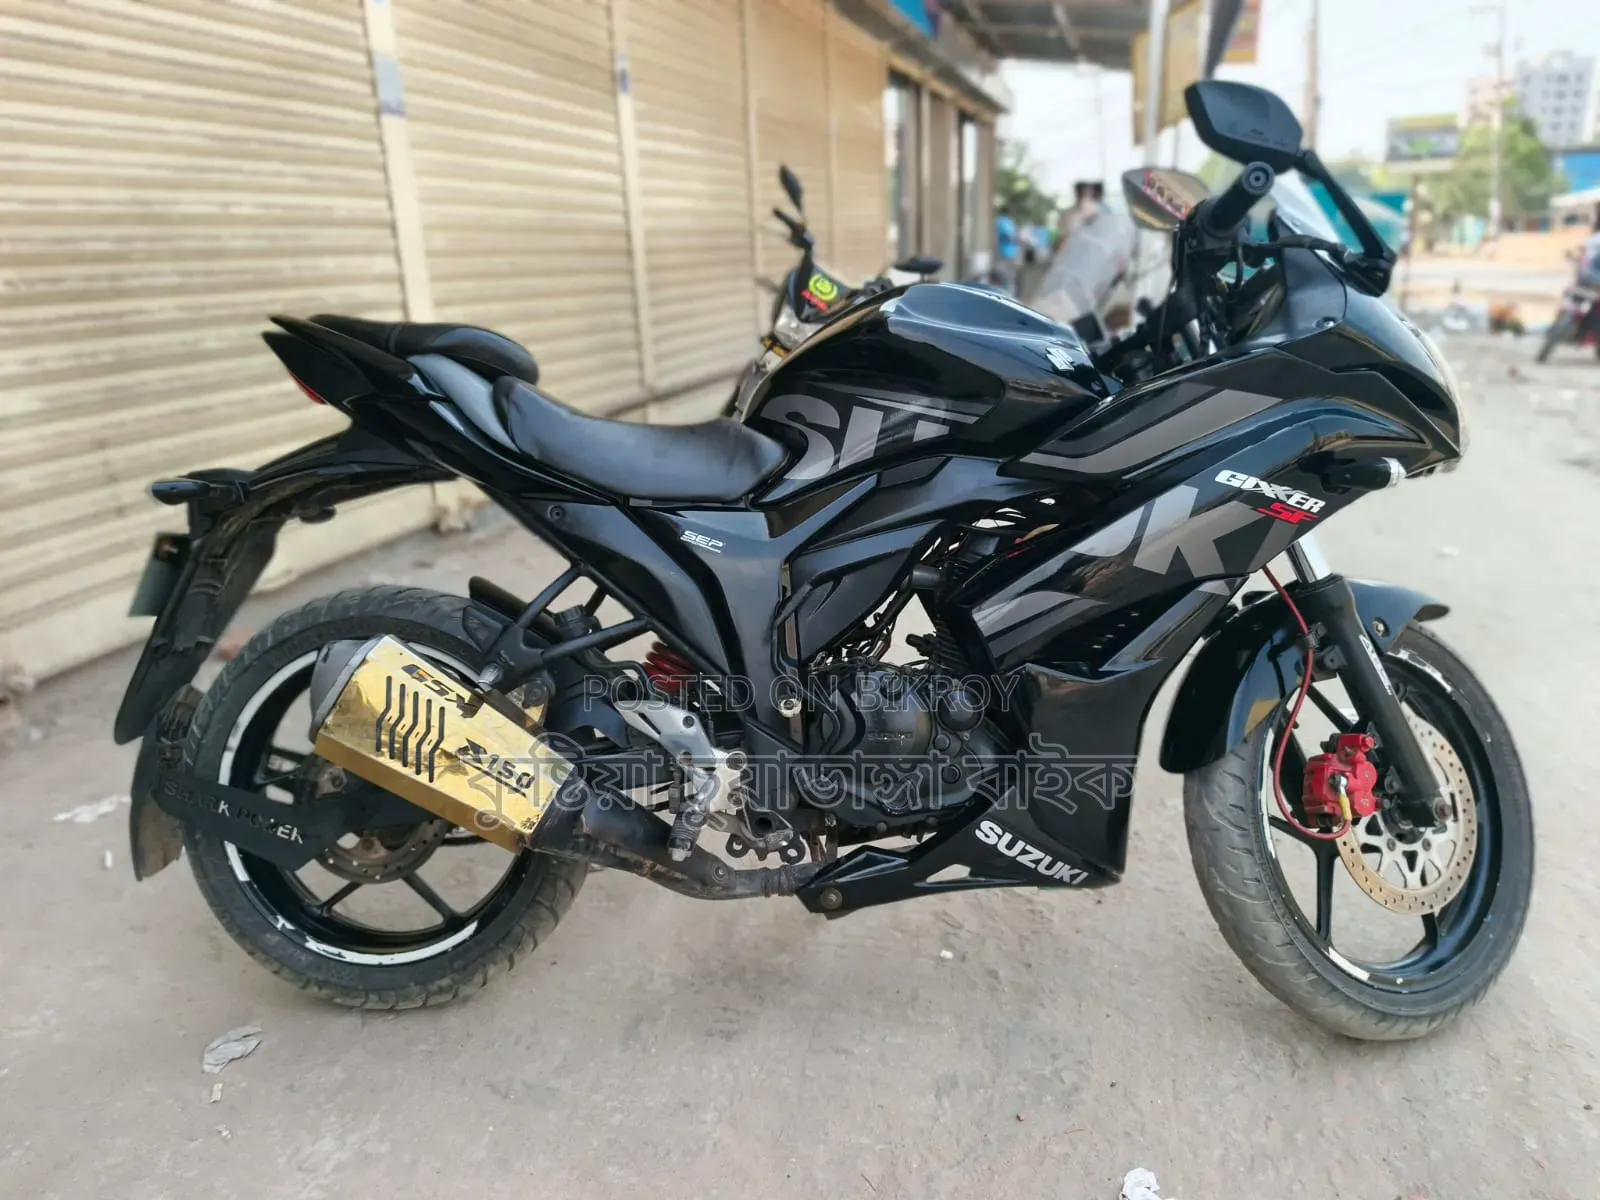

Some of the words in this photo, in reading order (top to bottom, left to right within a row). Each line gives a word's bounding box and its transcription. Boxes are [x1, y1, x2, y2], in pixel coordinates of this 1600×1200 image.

[1214, 469, 1326, 513] GIXXER
[1256, 502, 1320, 525] SF
[681, 530, 724, 548] SEP
[975, 820, 1089, 885] SUZUKI
